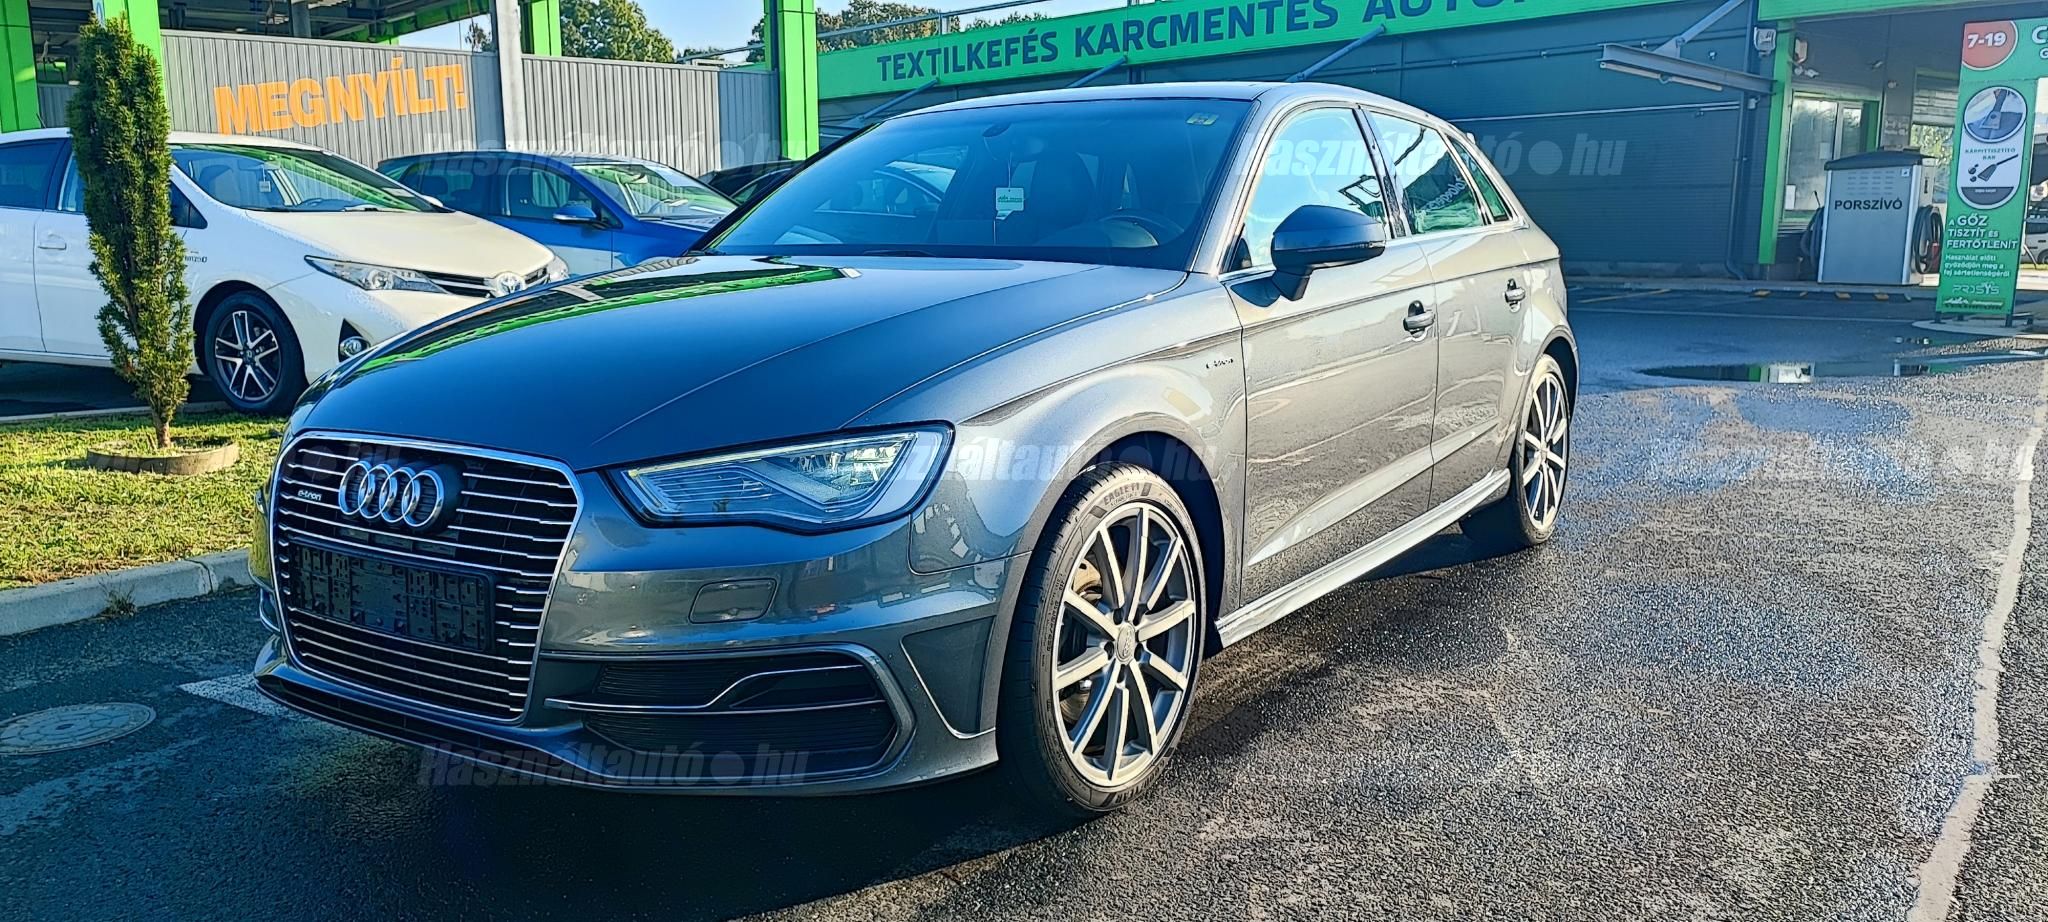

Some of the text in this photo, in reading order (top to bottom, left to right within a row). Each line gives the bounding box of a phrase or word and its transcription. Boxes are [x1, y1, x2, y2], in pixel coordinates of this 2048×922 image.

[876, 0, 1339, 82] TEXTILKEFÉS KARCMENTES
[1967, 32, 2007, 49] 7-19
[213, 55, 467, 135] MEGNYÍLT!
[1834, 197, 1903, 210] PORSZÍVÓ
[1957, 213, 1988, 226] GŐZ
[1948, 227, 1986, 237] TISZTÍT
[1946, 239, 2018, 249] FERTŐTLENÍT
[297, 489, 322, 501] e-tron
